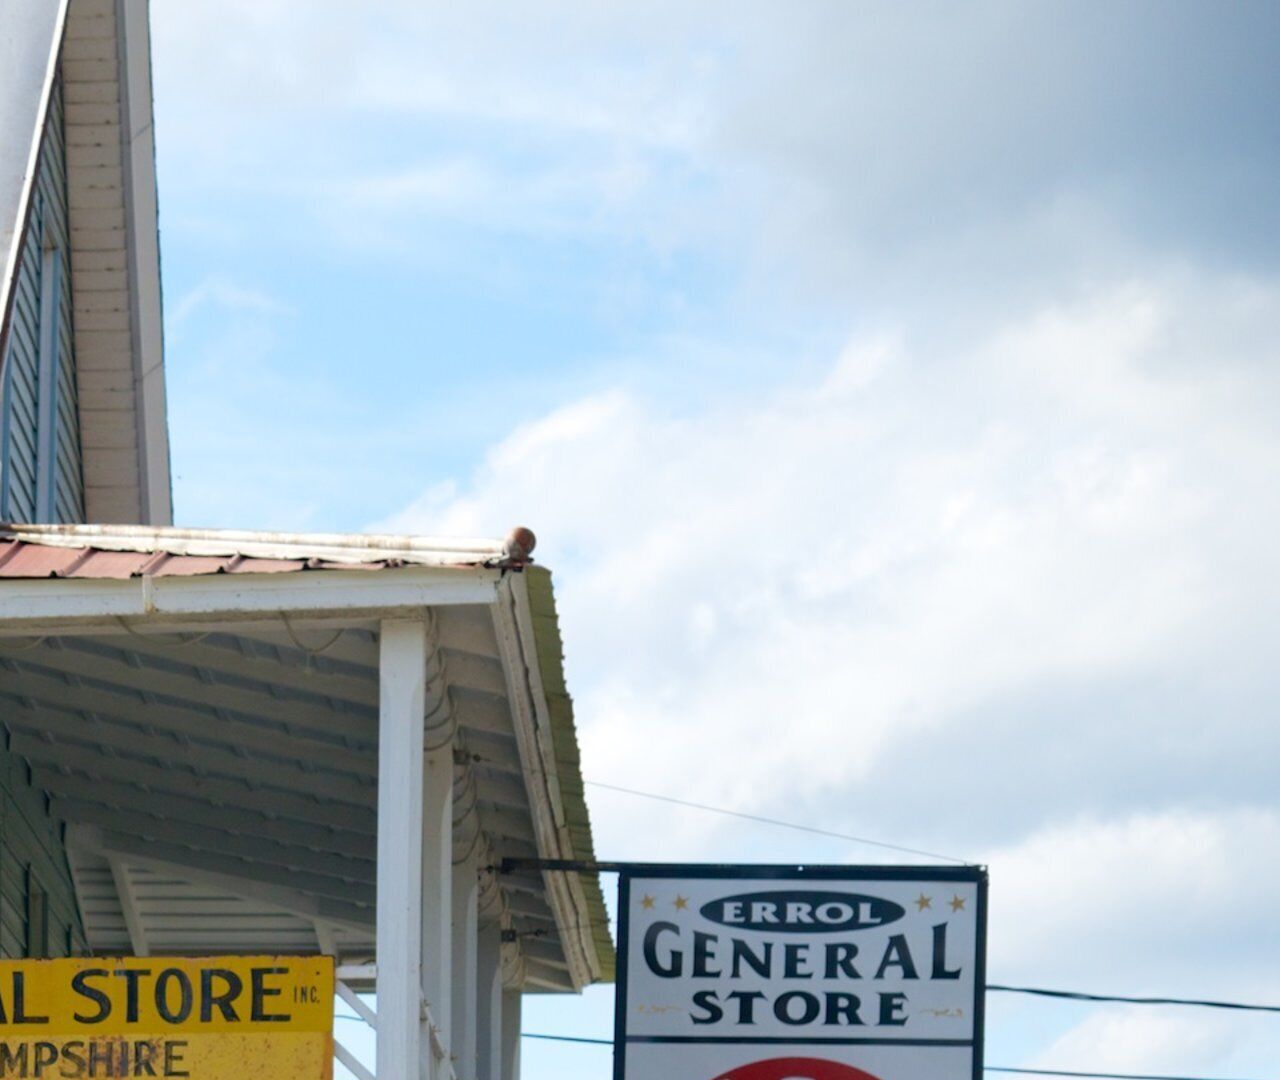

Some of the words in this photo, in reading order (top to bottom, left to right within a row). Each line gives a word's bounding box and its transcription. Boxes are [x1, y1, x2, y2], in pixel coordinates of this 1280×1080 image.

[721, 901, 883, 926] ERROL
[642, 919, 963, 981] GENERAL
[71, 967, 292, 1025] STORE
[689, 988, 910, 1028] STORE
